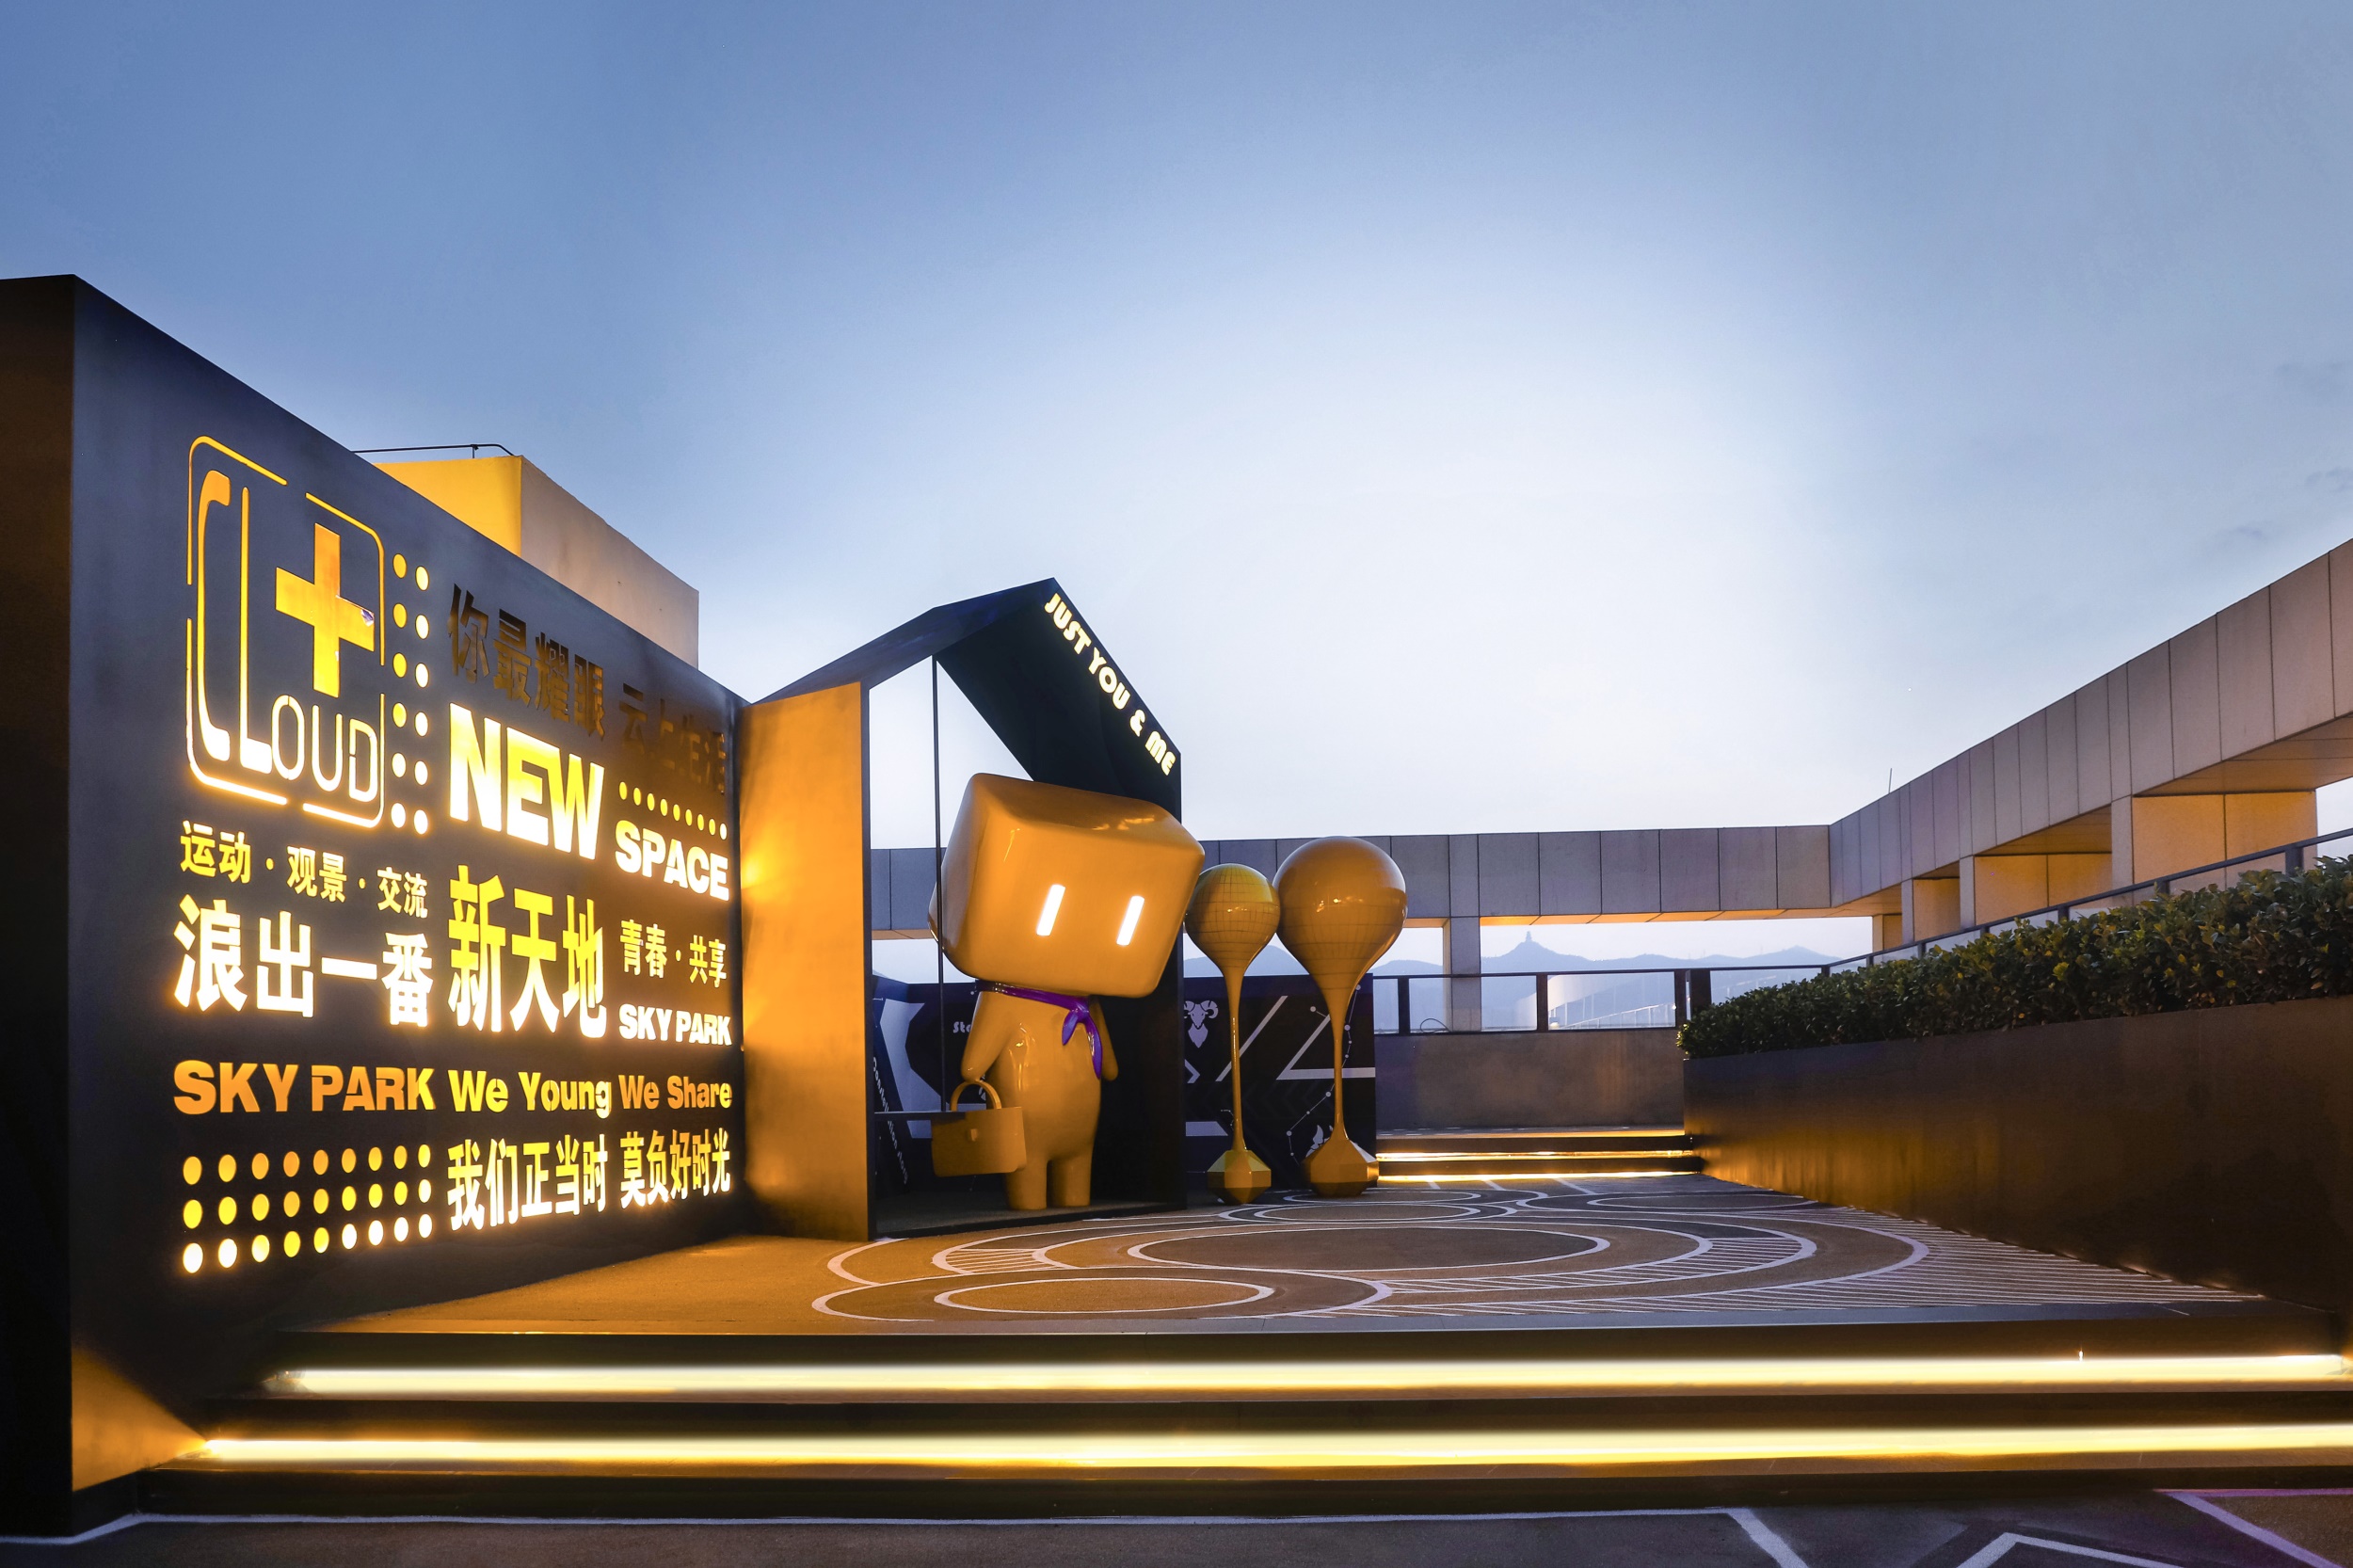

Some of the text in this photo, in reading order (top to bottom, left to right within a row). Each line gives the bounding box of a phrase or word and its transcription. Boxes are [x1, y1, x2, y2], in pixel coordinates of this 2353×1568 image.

[447, 583, 606, 742] 你最耀眼
[1044, 592, 1176, 776] JUST YOU & ME
[449, 702, 729, 902] NEW SPACE
[173, 864, 607, 1038] 浪出一番 新天地
[618, 1003, 732, 1047] SKY PARK
[173, 1060, 732, 1119] SKY PARK We Young We Share
[447, 1127, 731, 1232] 我们正当时 莫负好时光
